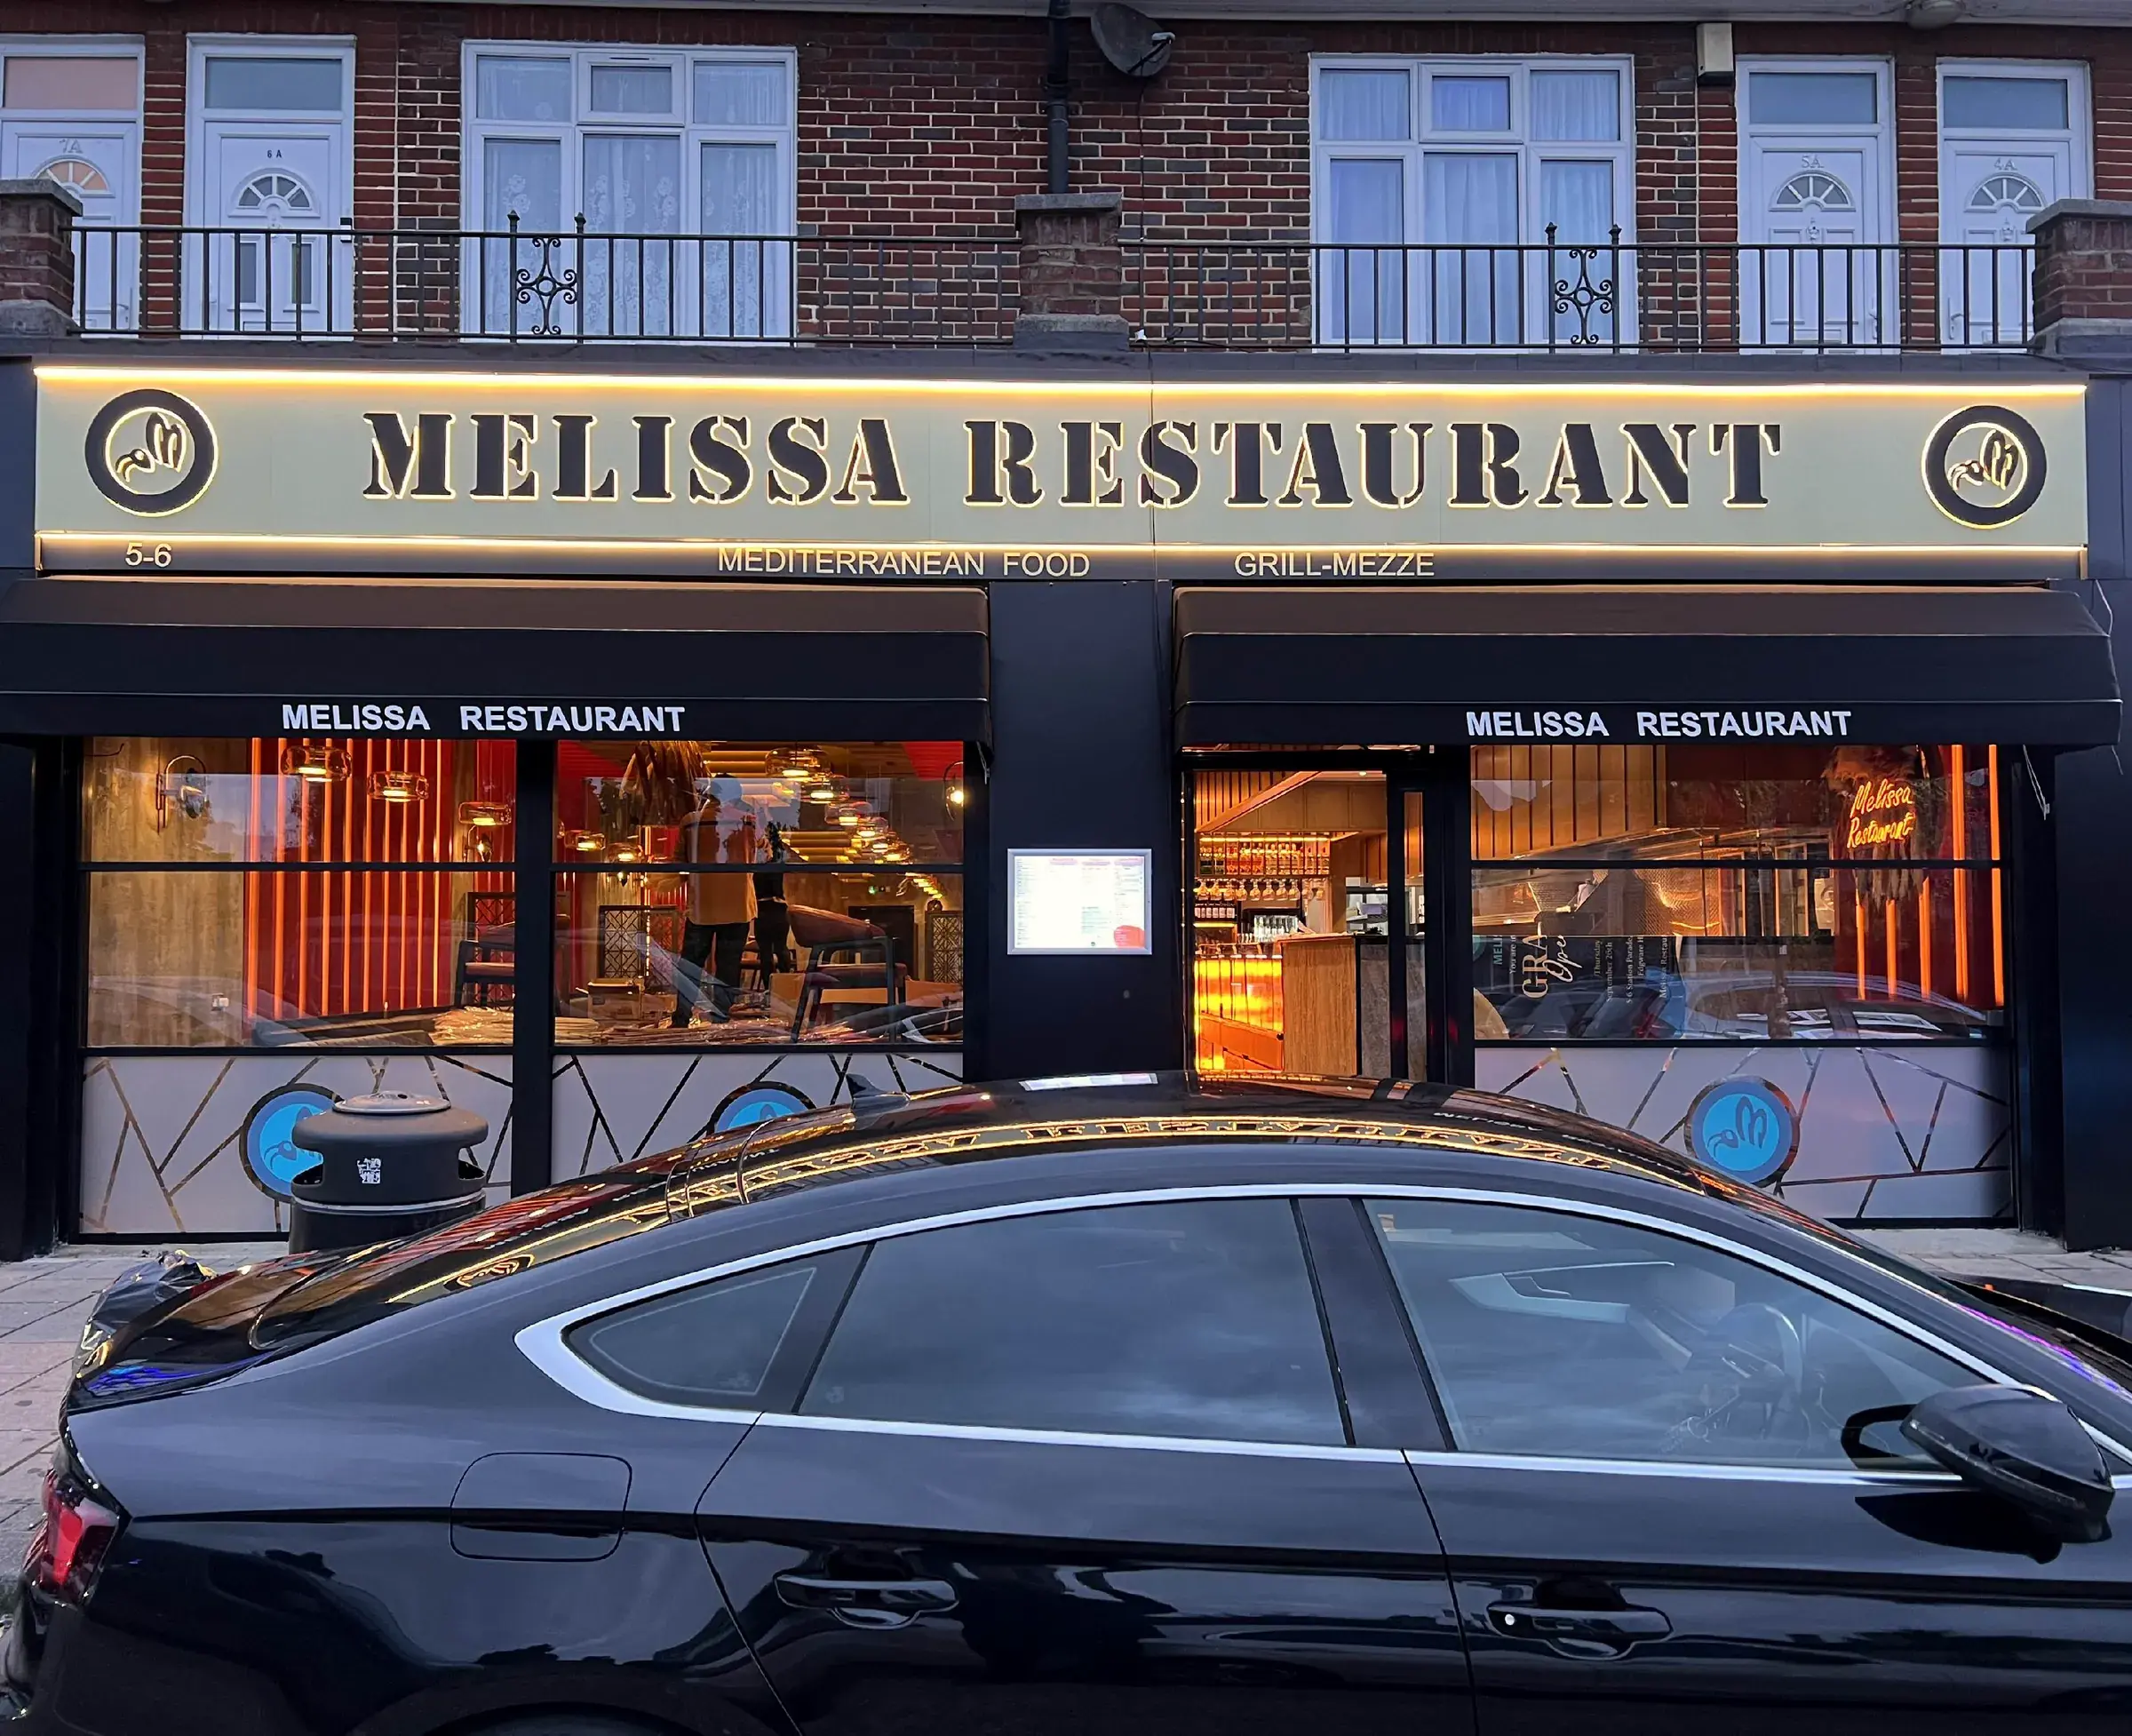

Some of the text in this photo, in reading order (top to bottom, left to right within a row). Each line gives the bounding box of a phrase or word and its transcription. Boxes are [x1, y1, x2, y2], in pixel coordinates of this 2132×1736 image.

[59, 138, 84, 155] 7A
[1801, 155, 1826, 169] 5A
[1993, 156, 2018, 171] 4A
[362, 412, 1782, 510] MELISSA RESTAURANT
[124, 541, 173, 569] 5-6
[717, 547, 1091, 577] MEDITERRANEAN FOOD
[1234, 551, 1436, 577] GRILL-MEZZE
[282, 704, 686, 732] MELISSA RESTAURANT
[1465, 711, 1852, 737] MELISSA RESTAURANT
[1849, 778, 1914, 819] Melissa
[1493, 935, 1503, 965] MELI
[1541, 935, 1582, 983] Ope
